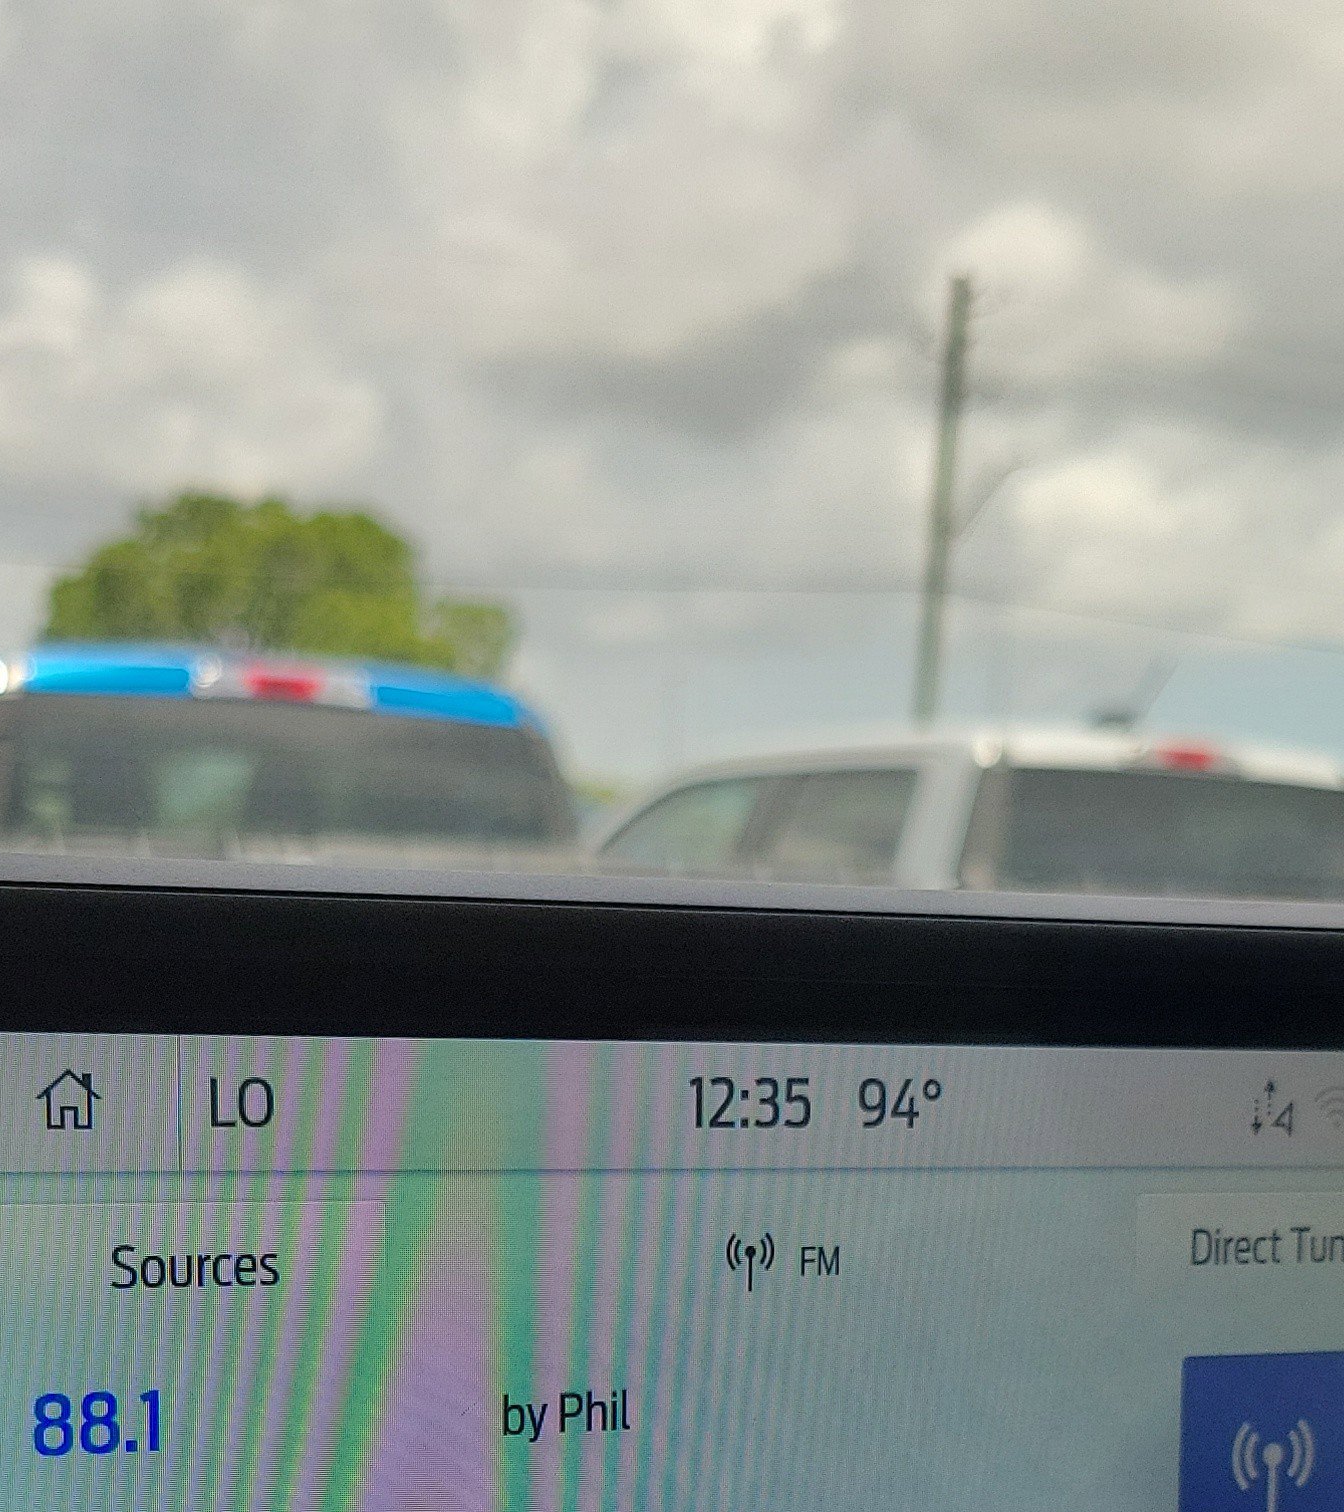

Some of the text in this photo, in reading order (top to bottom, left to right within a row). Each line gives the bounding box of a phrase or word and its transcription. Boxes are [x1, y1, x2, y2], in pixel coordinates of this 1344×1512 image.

[208, 1077, 275, 1128] LO
[689, 1077, 811, 1129] 12:35
[111, 1244, 280, 1289] Sources
[799, 1247, 841, 1277] FM
[1191, 1228, 1281, 1266] Direct
[33, 1389, 162, 1456] 88.1
[502, 1390, 631, 1441] by Phil
